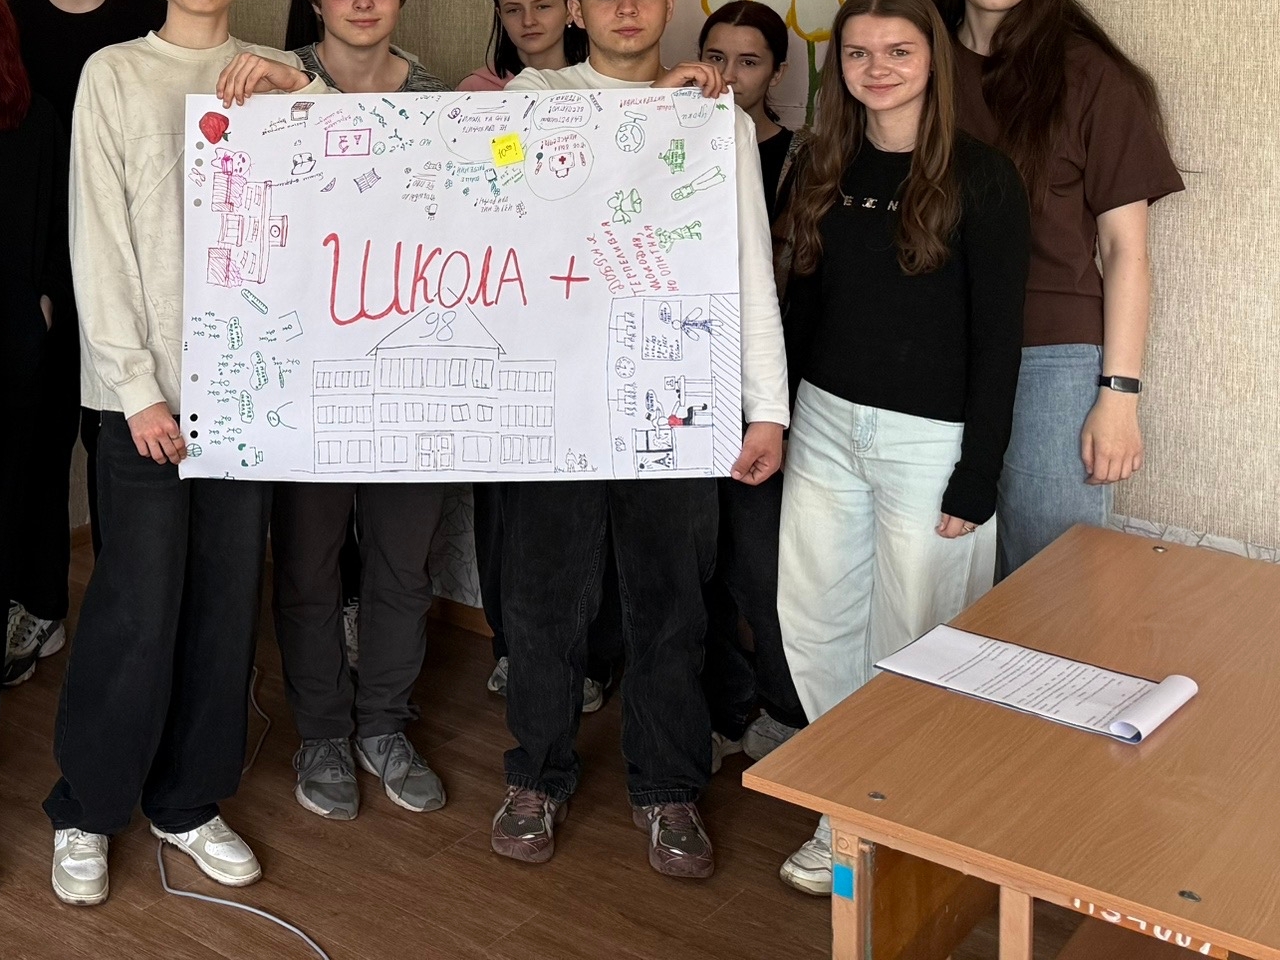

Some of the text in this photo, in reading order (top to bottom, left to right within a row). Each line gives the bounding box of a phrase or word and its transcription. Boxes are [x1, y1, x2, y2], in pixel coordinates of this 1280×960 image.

[323, 232, 528, 326] ШКОЛА
[601, 221, 646, 295] ТЕРПЕЛИВАЯ
[667, 278, 679, 292] НО
[420, 310, 454, 342] 98
